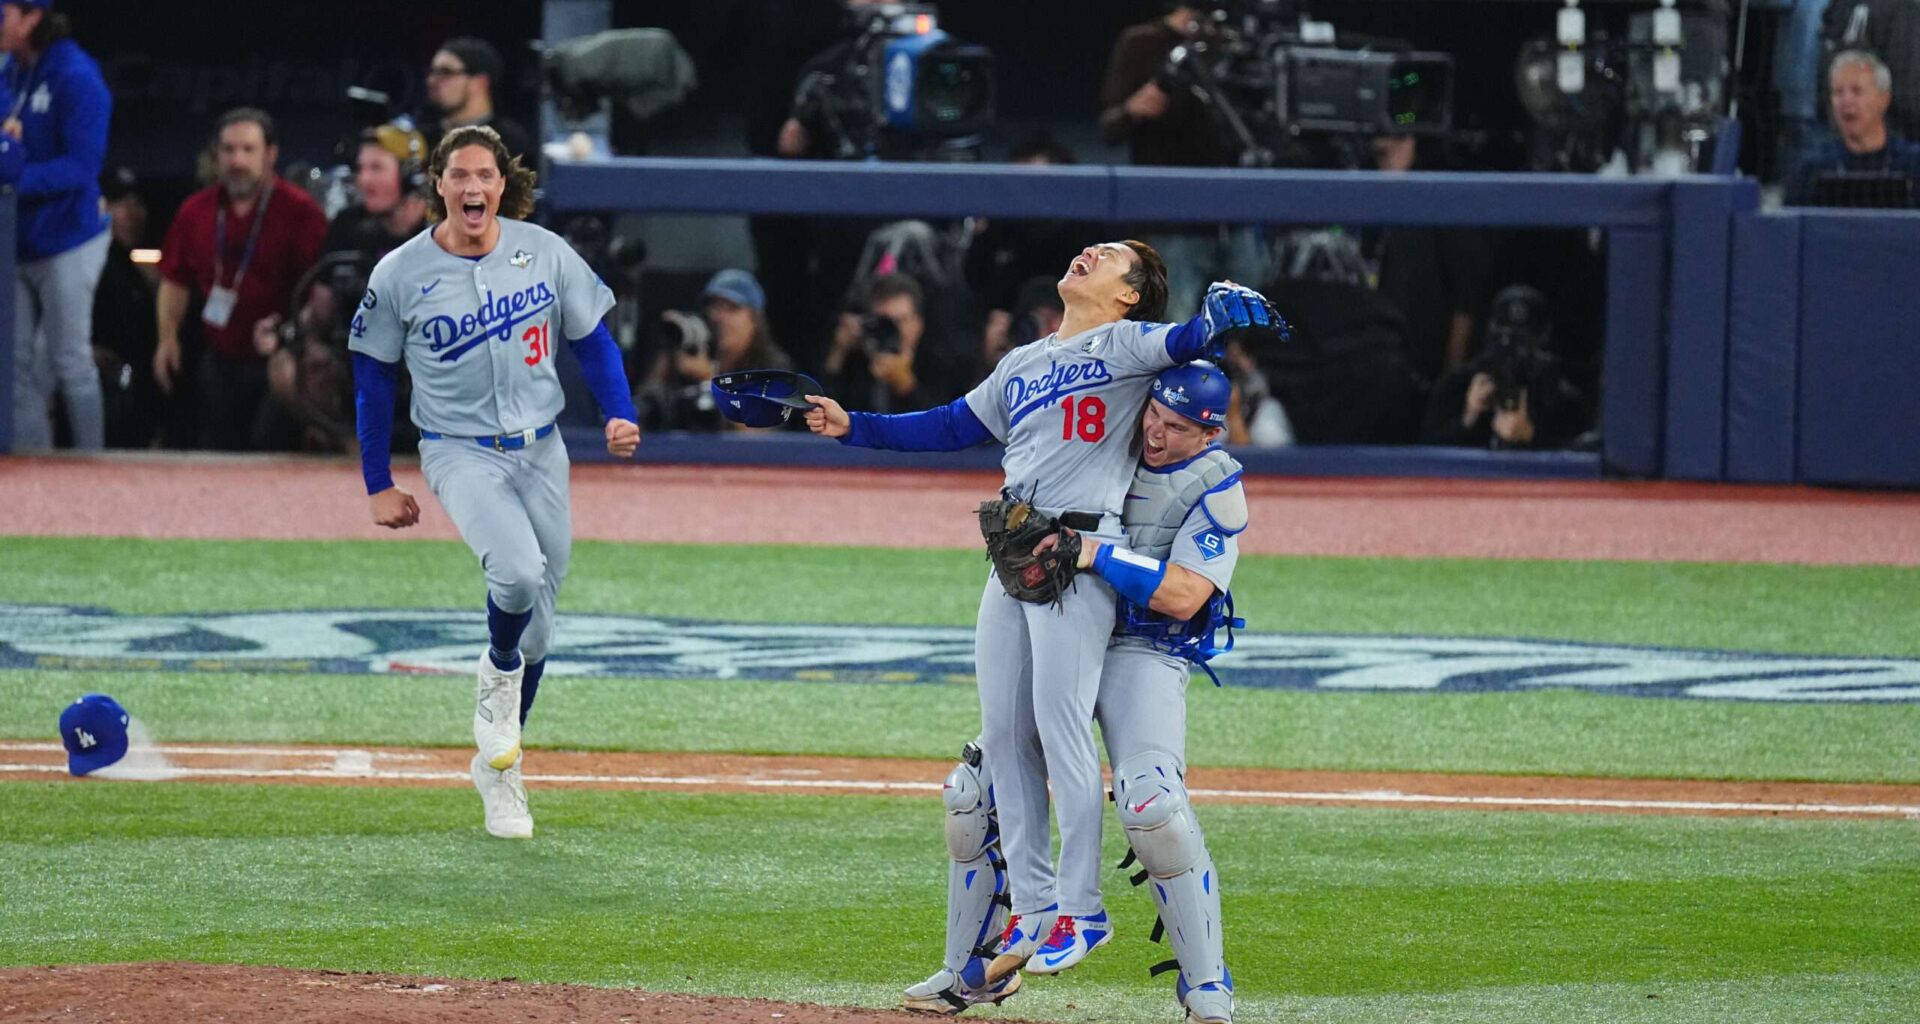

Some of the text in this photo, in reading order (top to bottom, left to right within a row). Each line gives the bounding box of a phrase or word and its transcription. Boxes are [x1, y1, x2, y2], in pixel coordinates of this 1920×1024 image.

[422, 281, 554, 362] Dodgers
[522, 318, 549, 367] 31
[1006, 359, 1112, 430] Dodgers
[1061, 395, 1106, 443] 18
[74, 726, 97, 749] LA
